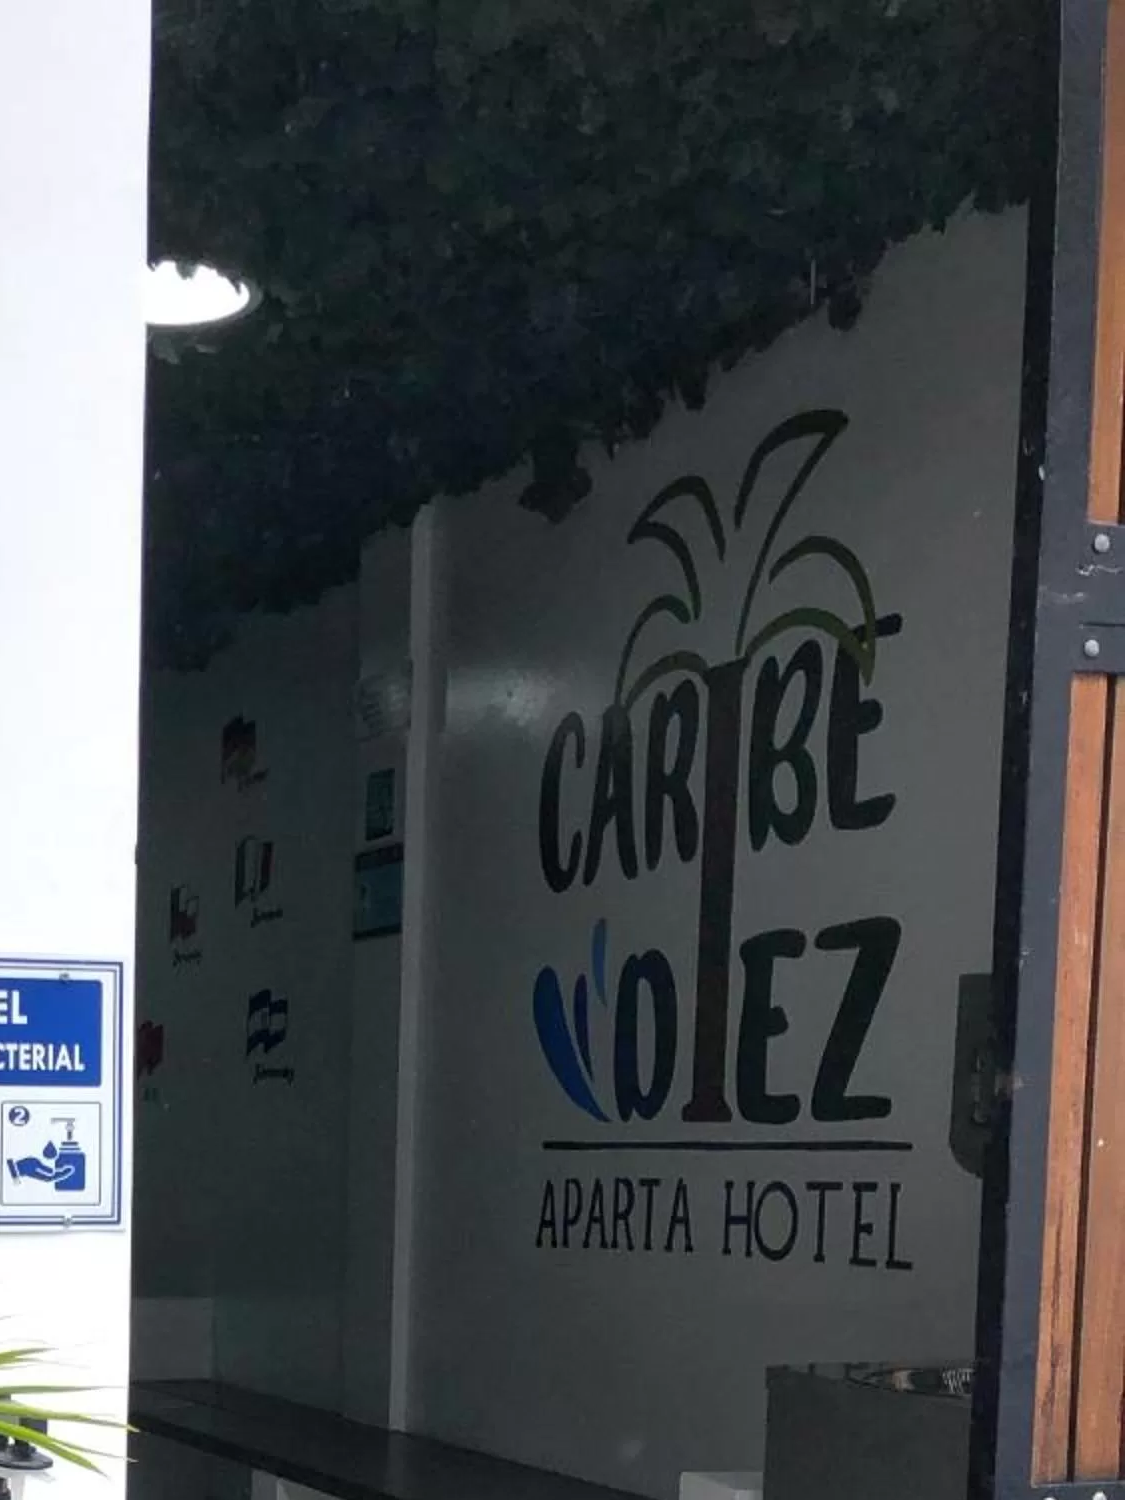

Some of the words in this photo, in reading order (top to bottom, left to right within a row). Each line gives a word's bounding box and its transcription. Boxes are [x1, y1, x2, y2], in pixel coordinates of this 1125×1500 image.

[539, 613, 902, 893] CARIBE
[616, 916, 902, 1122] DIEZ
[536, 1178, 694, 1252] APARTA
[723, 1180, 914, 1270] HOTEL
